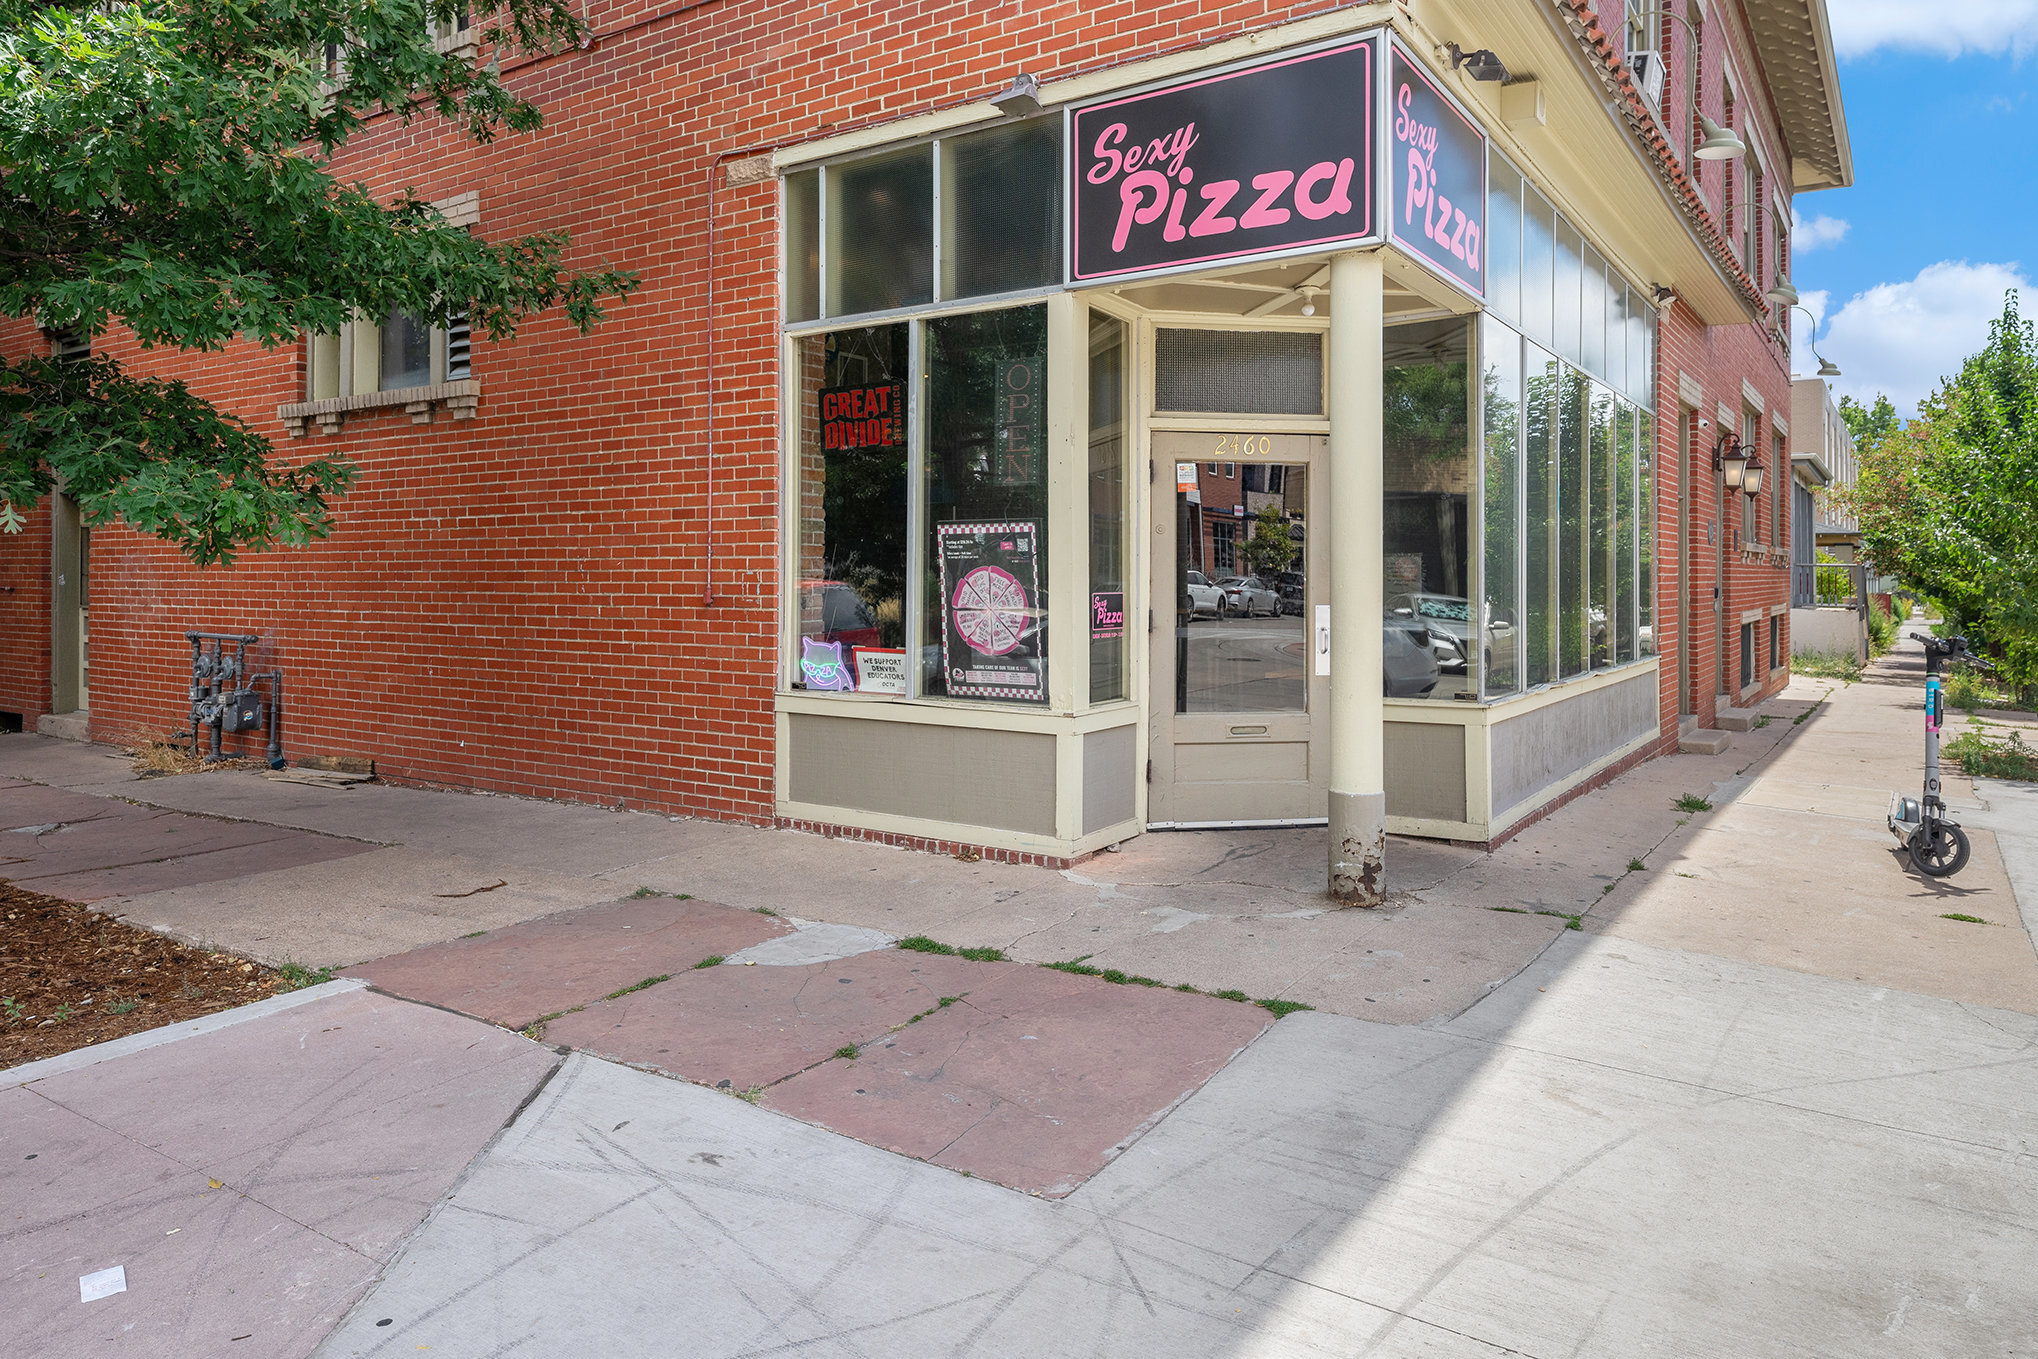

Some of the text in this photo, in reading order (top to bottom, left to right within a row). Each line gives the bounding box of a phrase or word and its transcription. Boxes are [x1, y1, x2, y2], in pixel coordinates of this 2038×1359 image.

[1396, 82, 1439, 171] Sexy
[1087, 122, 1200, 185] Sexy
[1111, 157, 1355, 253] Pizza
[1406, 146, 1480, 273] Pizza
[823, 386, 891, 420] GREAT
[824, 417, 893, 450] DIVIDE
[1005, 363, 1032, 482] OPEN
[1214, 434, 1271, 456] 2460
[1097, 607, 1123, 624] Pizza
[867, 672, 905, 680] EDUCATORS
[871, 665, 897, 673] DENVER
[874, 658, 902, 666] SUPPORT
